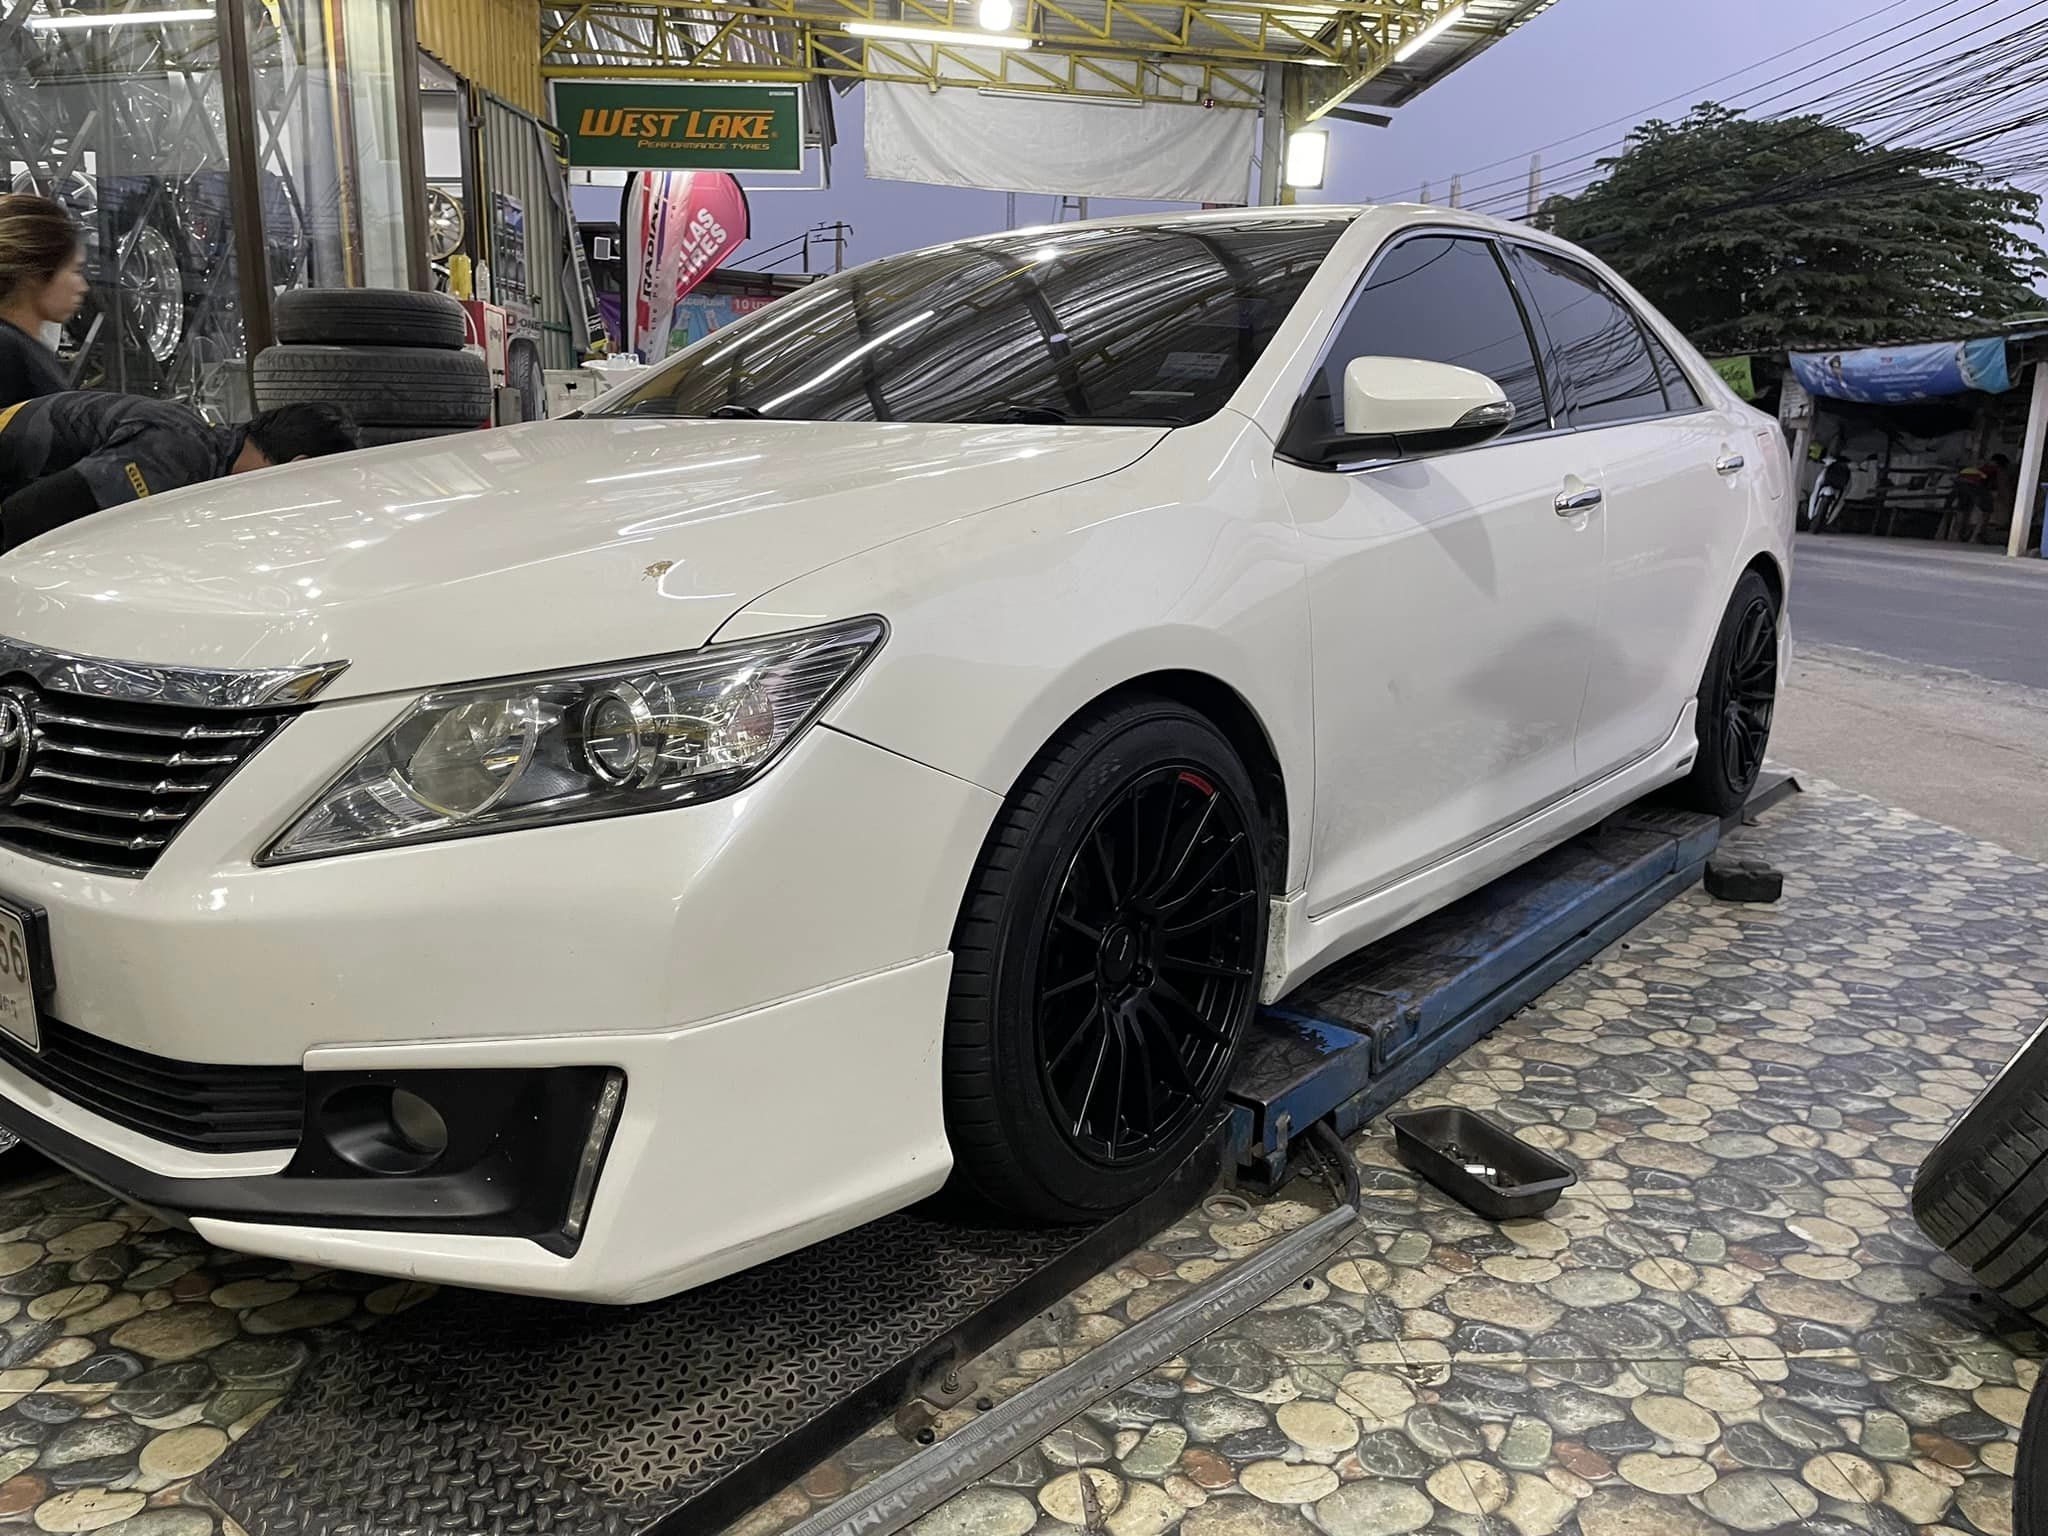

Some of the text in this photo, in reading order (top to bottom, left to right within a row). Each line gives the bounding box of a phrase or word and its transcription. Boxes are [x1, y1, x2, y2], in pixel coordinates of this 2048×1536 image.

[579, 108, 774, 139] WEST LAKE
[638, 139, 770, 151] PERFORMANCE TYRES
[679, 207, 715, 268] LAS
